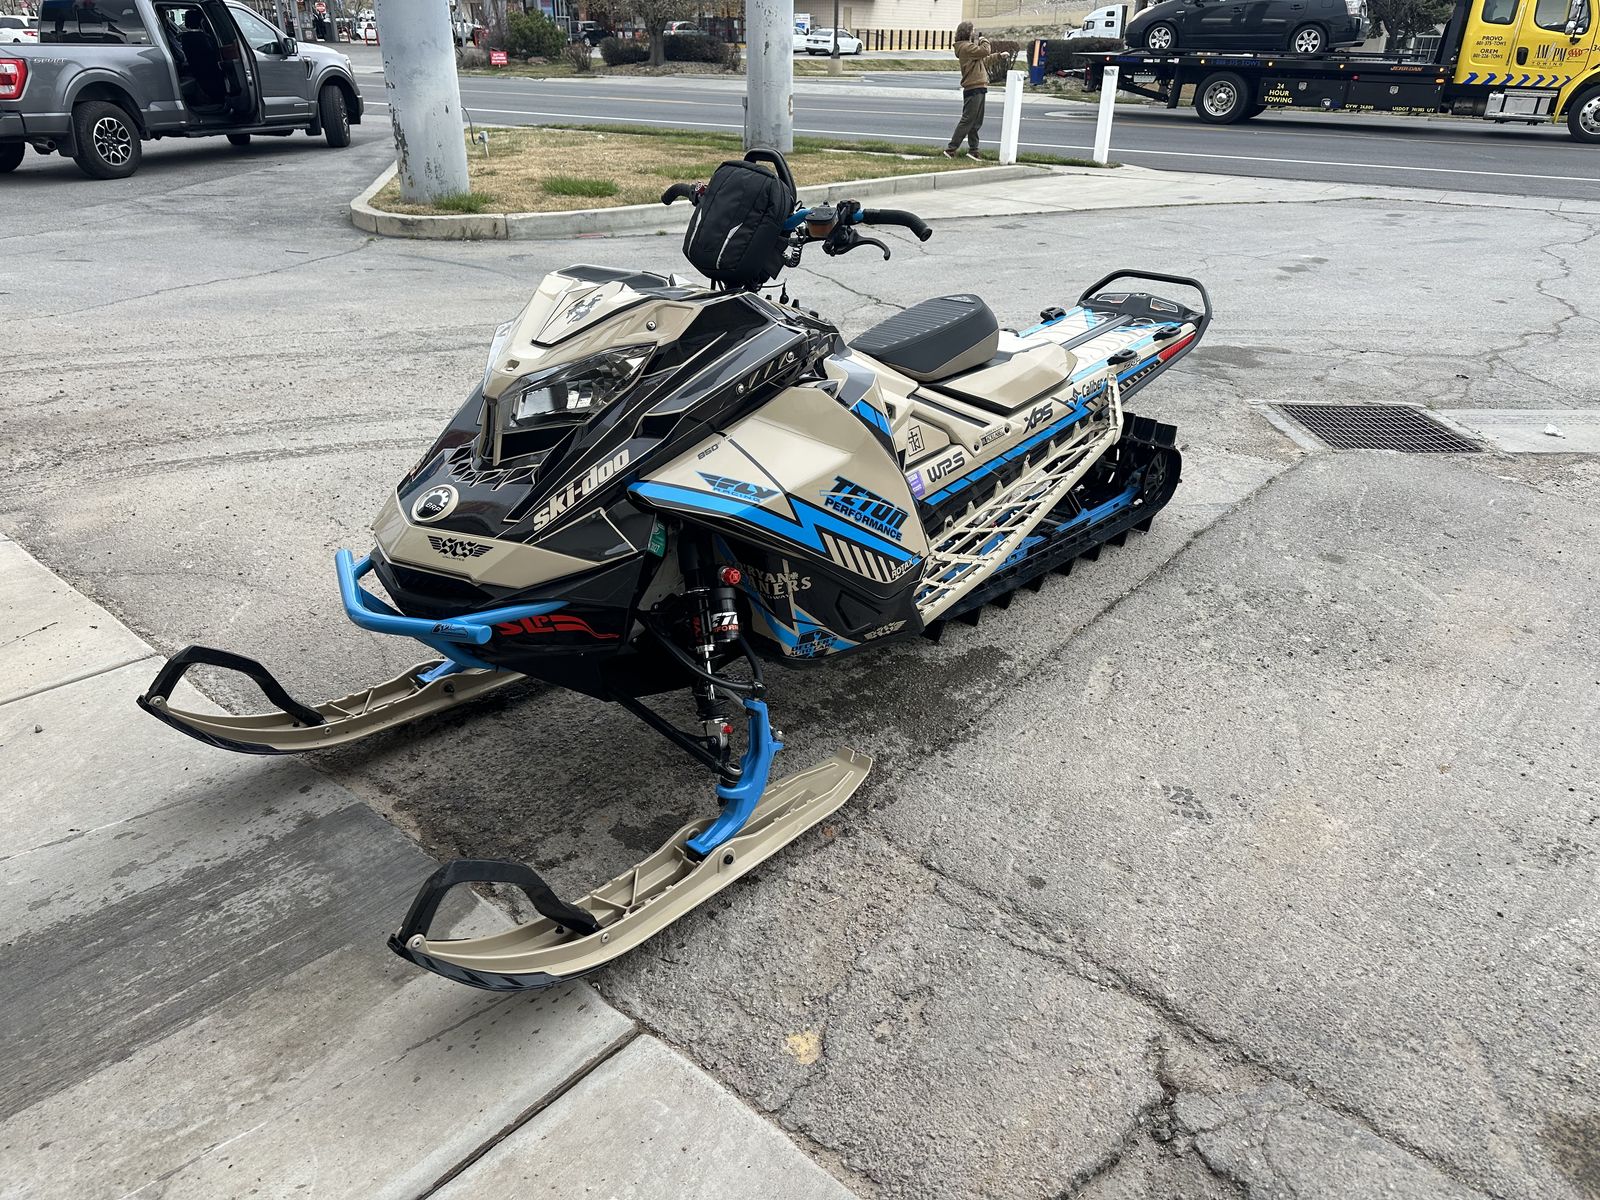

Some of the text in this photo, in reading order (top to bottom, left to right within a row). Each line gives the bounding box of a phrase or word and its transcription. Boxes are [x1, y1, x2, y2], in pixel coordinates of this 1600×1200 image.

[1263, 96, 1293, 104] TOWING
[1269, 89, 1290, 97] HOUR
[1081, 377, 1107, 397] Caliber
[1023, 401, 1054, 434] XPS
[697, 443, 719, 460] 850
[926, 451, 966, 483] WPS
[533, 448, 630, 531] ski-doo
[695, 470, 781, 499] FLY
[713, 487, 761, 502] RACING
[425, 501, 442, 512] BRP
[828, 475, 911, 531] TETON
[824, 497, 903, 541] PERFORMANCE
[891, 553, 919, 579] ROTAX
